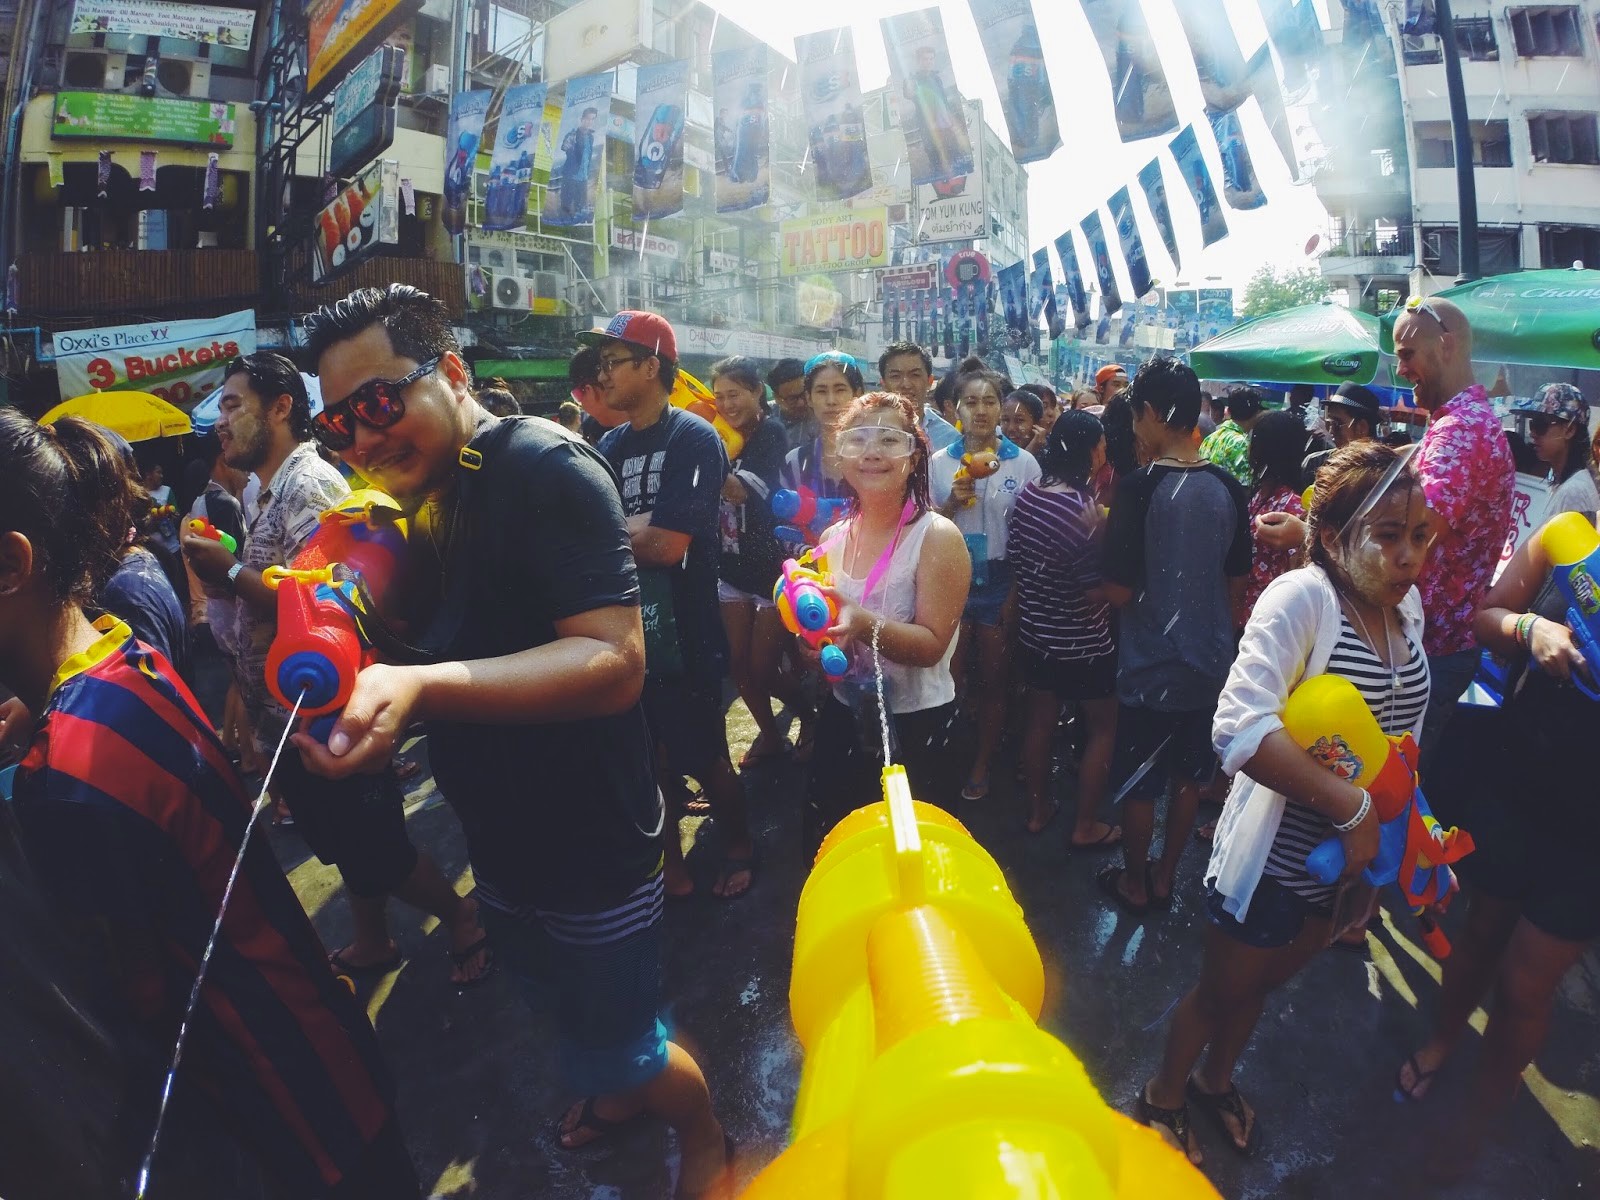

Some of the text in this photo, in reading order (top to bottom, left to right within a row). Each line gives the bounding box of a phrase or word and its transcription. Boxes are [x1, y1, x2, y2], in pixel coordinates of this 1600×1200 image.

[91, 7, 116, 15] Massage
[130, 10, 155, 18] Massage
[172, 13, 196, 21] Massage
[940, 204, 957, 219] YUM
[960, 201, 983, 217] KUNG
[811, 214, 853, 227] BODY ART
[615, 232, 677, 255] BAMBOO
[784, 220, 884, 267] TATTOO
[958, 251, 976, 259] true
[814, 262, 843, 271] TATTOO
[844, 258, 872, 268] GROUP
[60, 331, 150, 352] Oxxi's Place
[87, 340, 240, 389] 3 Buckets
[1334, 358, 1359, 369] Chang
[645, 614, 659, 631] IT!
